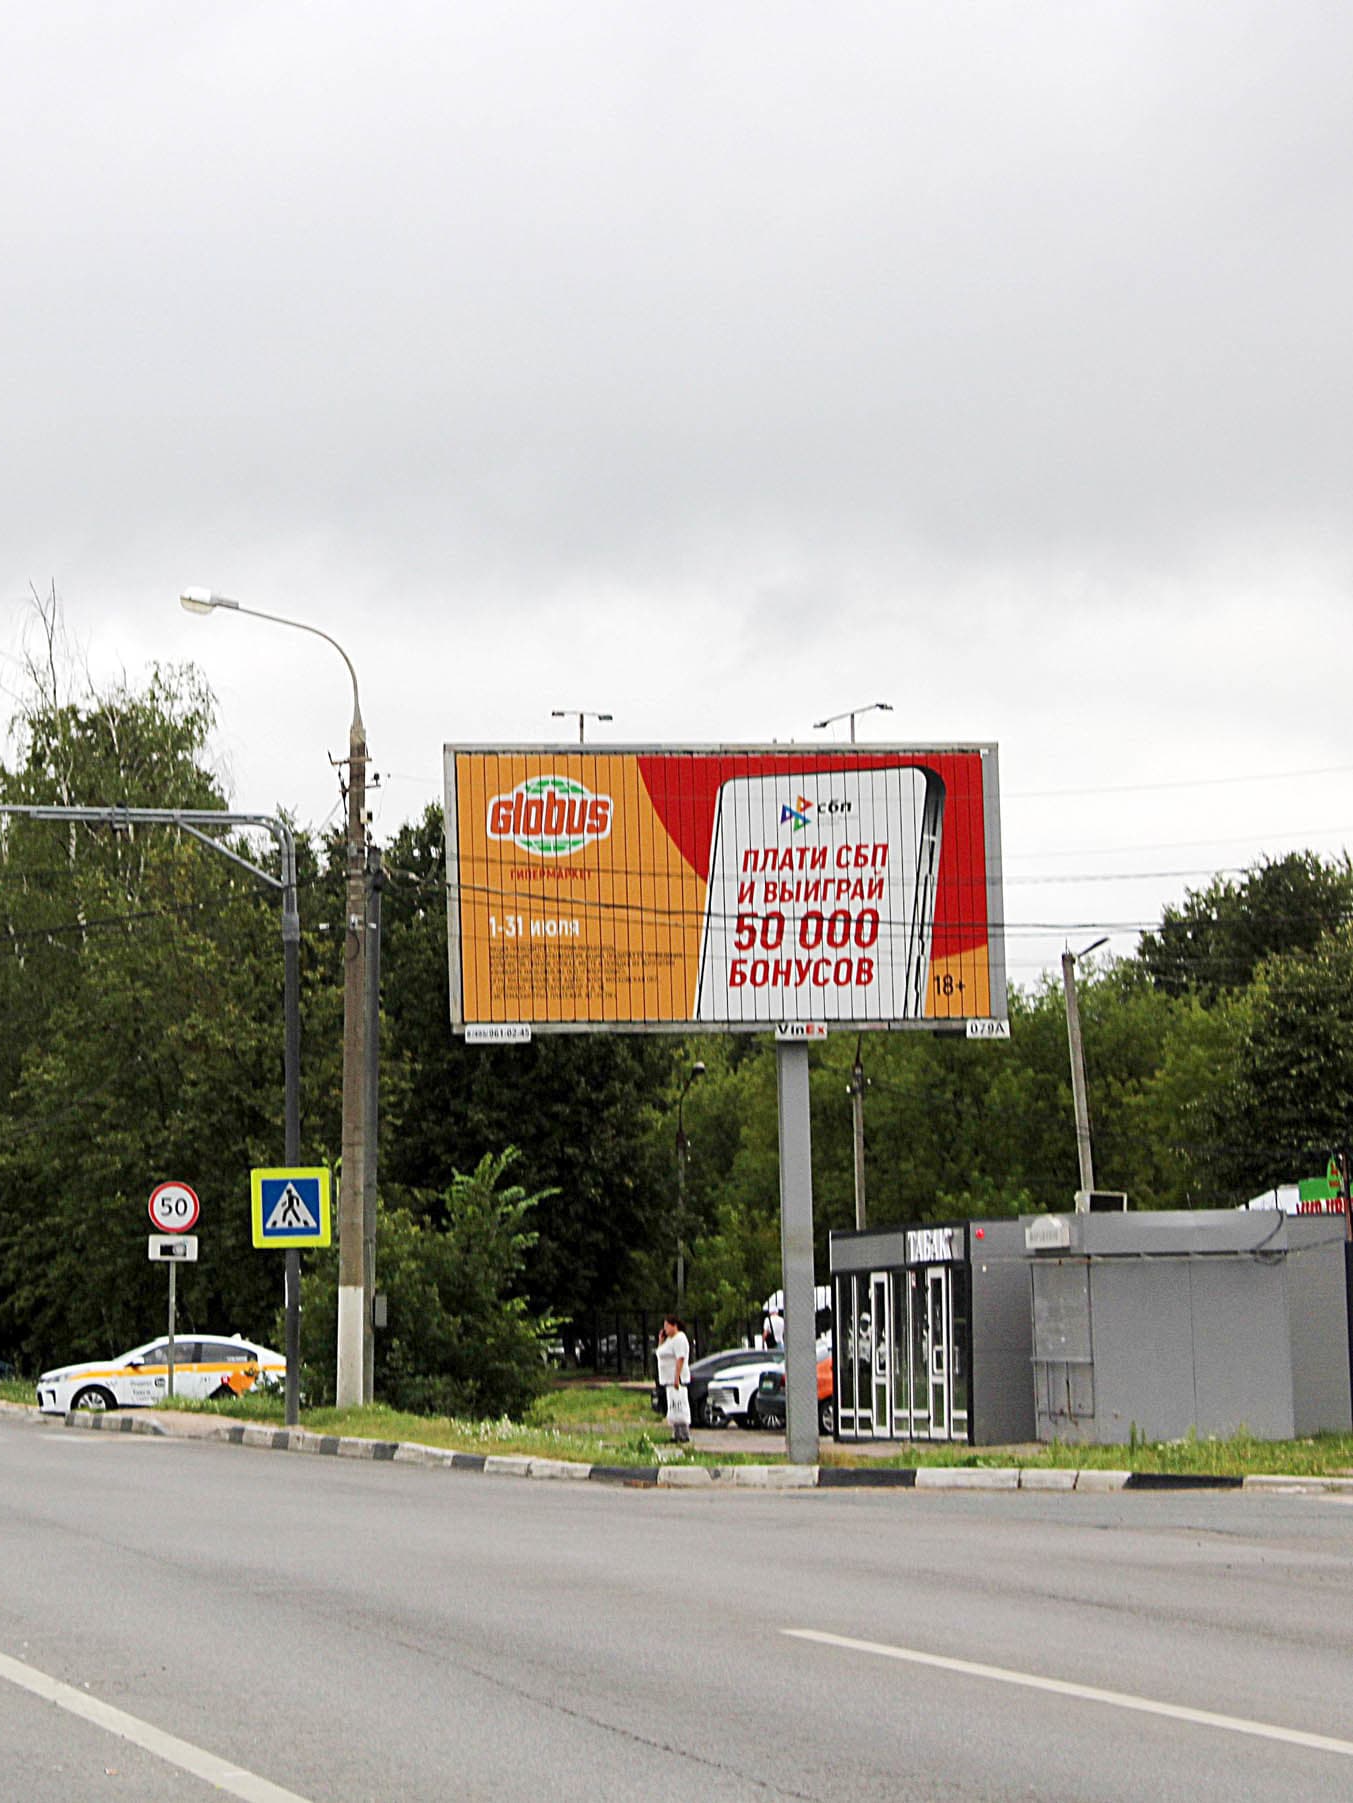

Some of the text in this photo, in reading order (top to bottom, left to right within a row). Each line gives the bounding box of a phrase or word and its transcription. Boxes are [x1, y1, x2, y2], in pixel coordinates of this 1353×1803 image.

[490, 790, 610, 836] Globus
[742, 843, 889, 873] ПЛАТИ СБП
[510, 867, 592, 881] ГИПЕРМАРКЕТ
[737, 870, 885, 904] И ВЫИГРАЙ
[489, 915, 580, 937] 1-31 июля
[734, 908, 880, 951] 50 000
[729, 957, 874, 988] БОНУСОВ
[935, 974, 965, 996] 18+
[161, 1197, 188, 1217] 50
